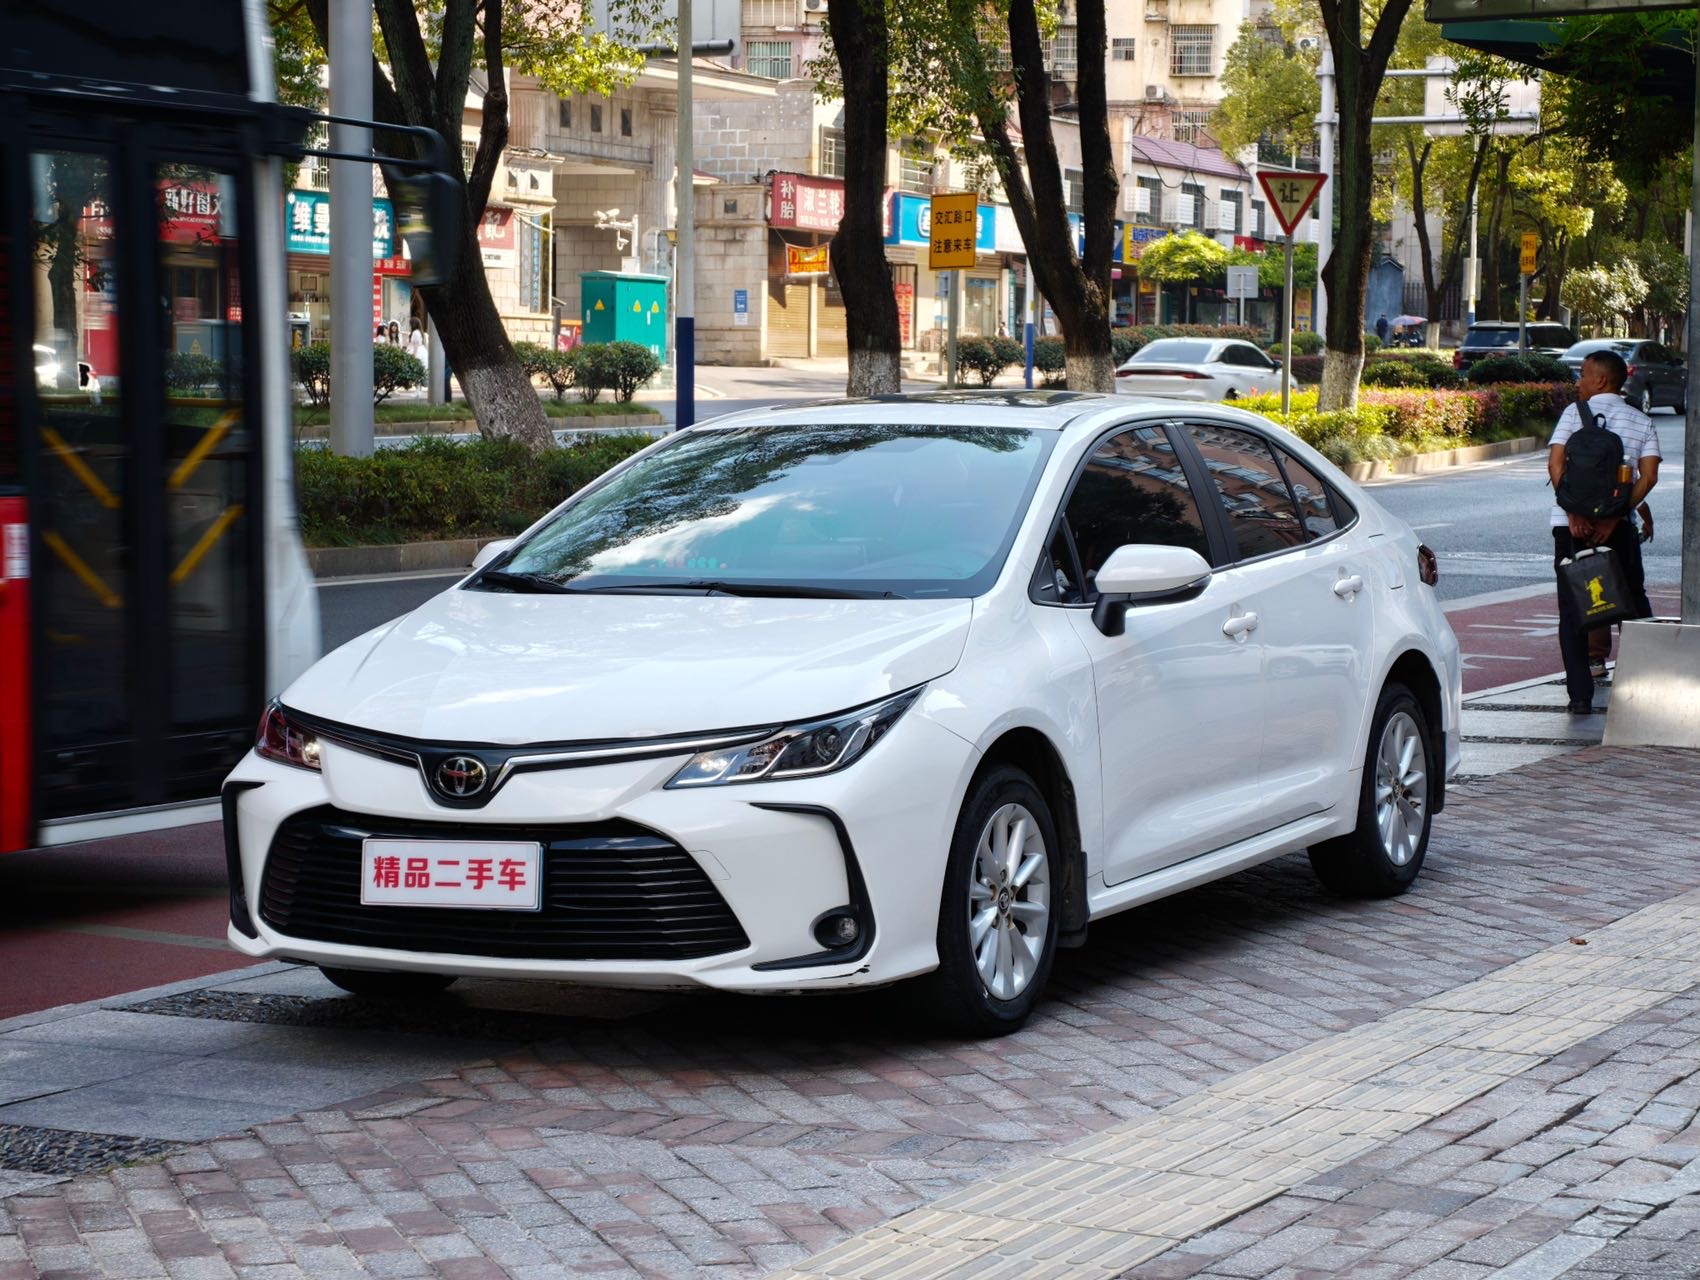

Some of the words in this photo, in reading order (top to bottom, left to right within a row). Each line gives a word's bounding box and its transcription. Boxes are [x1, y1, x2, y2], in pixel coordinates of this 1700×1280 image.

[780, 180, 795, 219] 补胎
[1279, 182, 1299, 203] 让
[935, 209, 972, 225] 交汇路口
[933, 237, 972, 254] 注意来车
[373, 856, 527, 891] 精品二手车
